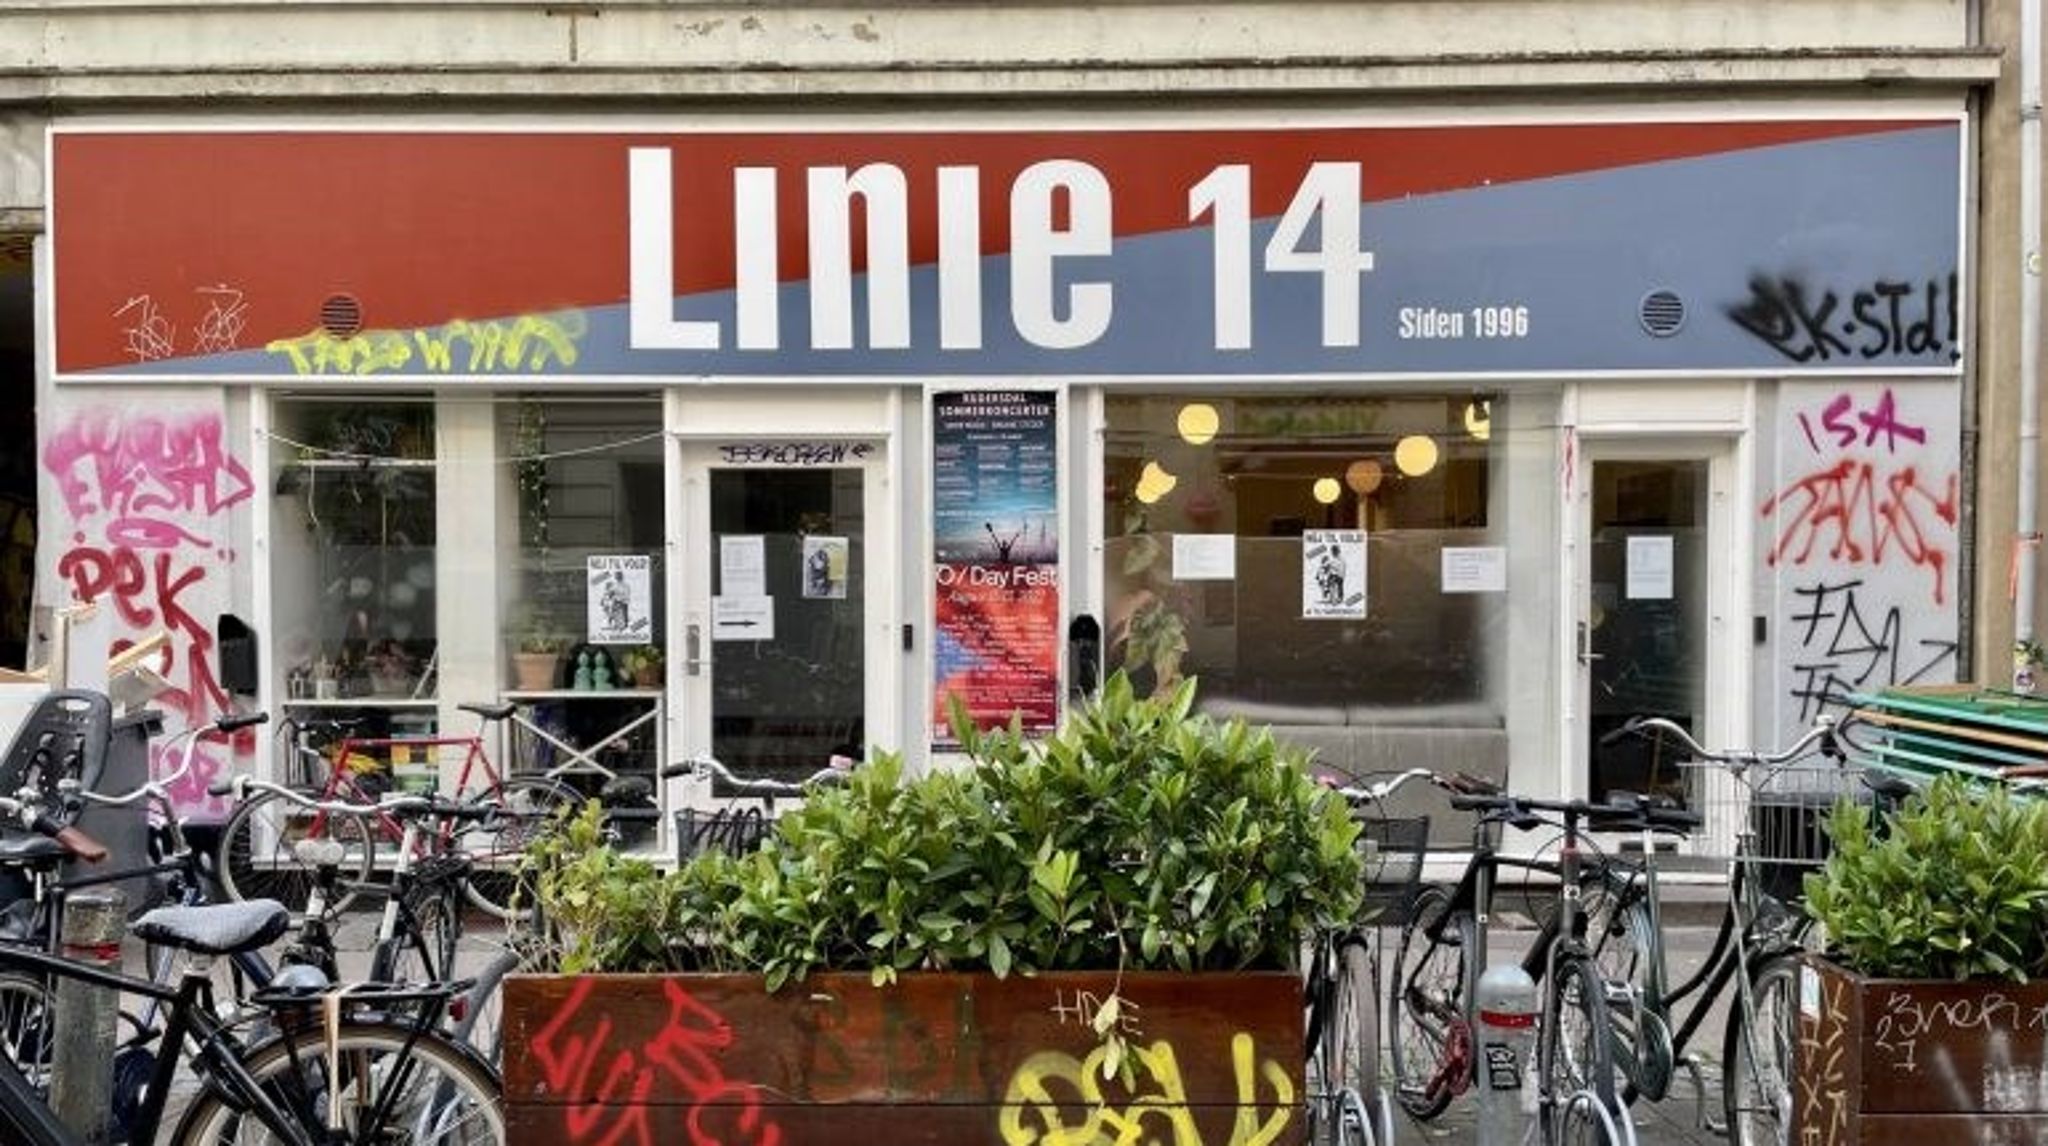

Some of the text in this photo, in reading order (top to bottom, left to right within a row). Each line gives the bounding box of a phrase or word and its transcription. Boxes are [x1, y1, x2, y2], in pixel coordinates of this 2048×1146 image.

[1188, 161, 1375, 347] 14
[1399, 306, 1528, 338] Siden 1996
[970, 566, 1009, 589] Day
[1012, 565, 1058, 587] Fest
